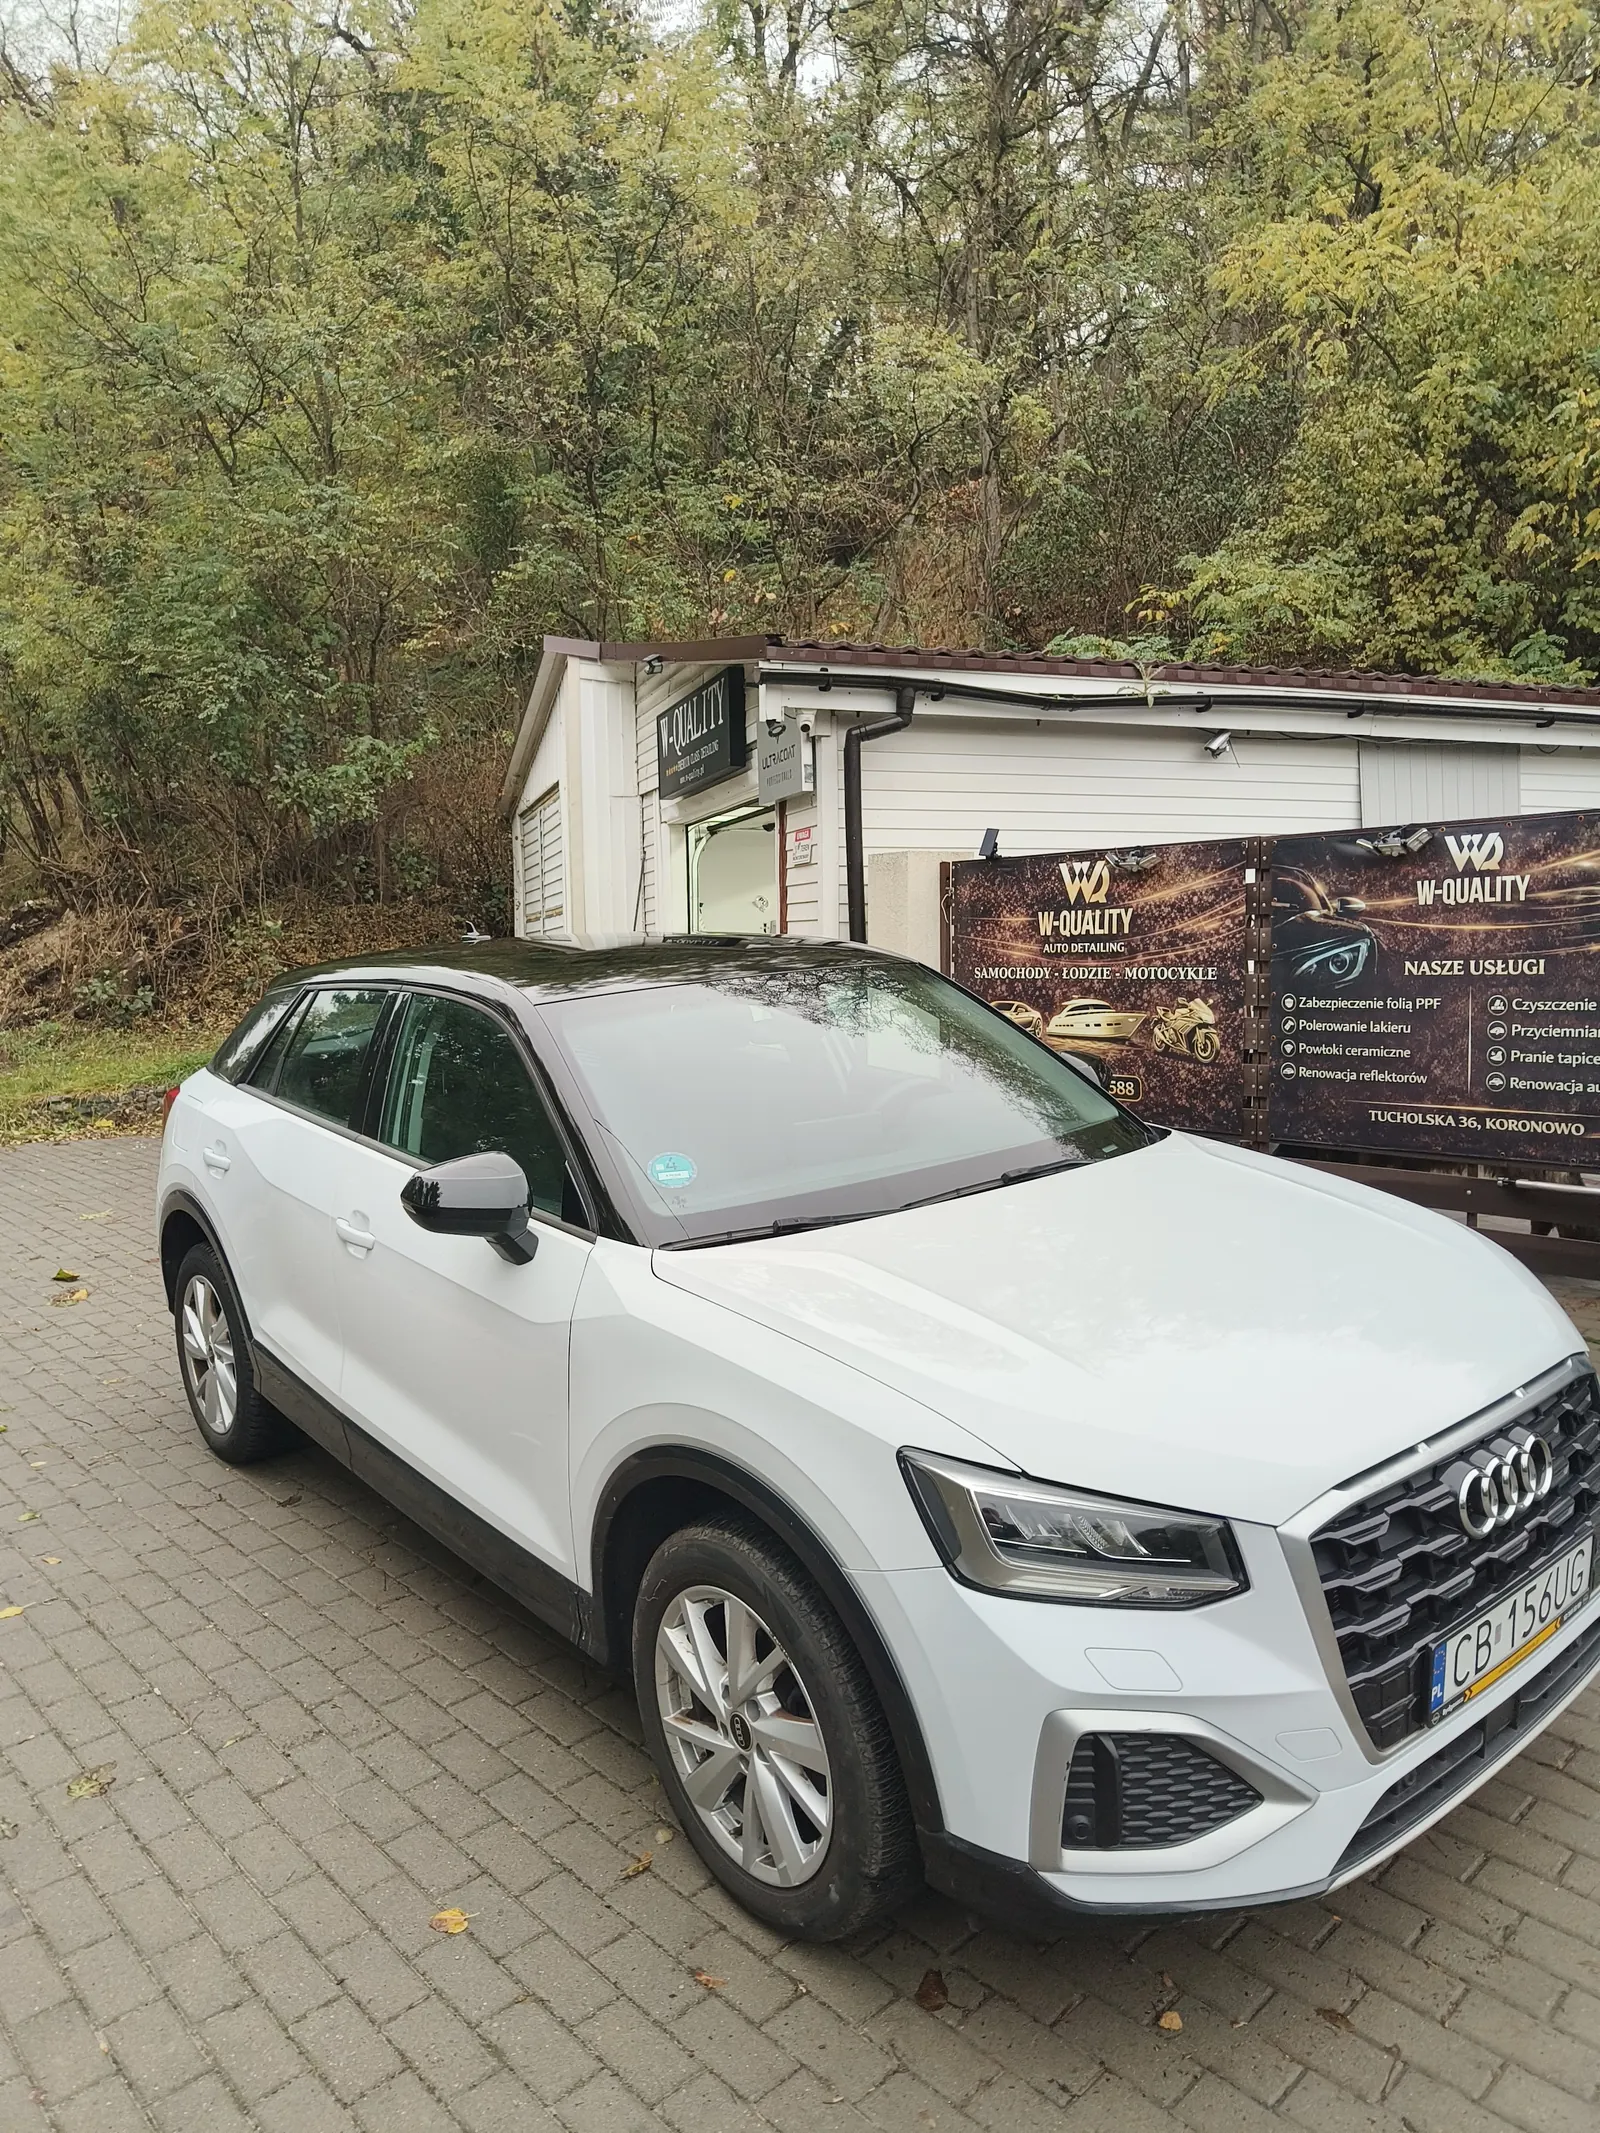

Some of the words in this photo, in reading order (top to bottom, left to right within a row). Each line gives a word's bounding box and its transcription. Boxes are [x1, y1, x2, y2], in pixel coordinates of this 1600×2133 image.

[660, 678, 724, 758] W-QUALITY
[762, 744, 795, 769] ULTRACOAT
[1416, 874, 1530, 906] W-QUALITY
[1037, 908, 1133, 937] W-QUALITY
[1043, 943, 1069, 954] AUTO
[1071, 942, 1125, 953] DETAILING
[974, 967, 1052, 980] SAMOCHODY
[1062, 967, 1111, 980] ŁODZIE
[1124, 967, 1217, 980] MOTOCYKLE
[1403, 960, 1464, 976] NASZE
[1469, 958, 1545, 975] USŁUGI
[1299, 997, 1384, 1011] Zabezpieczenie
[1387, 997, 1413, 1012] folią
[1415, 998, 1441, 1009] PPF
[1512, 998, 1597, 1014] Czyszczenie
[1299, 1020, 1367, 1032] Polerowanie
[1370, 1021, 1411, 1033] lakieru
[1511, 1024, 1600, 1040] Przyciemnia
[1299, 1043, 1343, 1055] Powłoki
[1345, 1046, 1411, 1058] ceramiczne
[1510, 1050, 1554, 1063] Pranie
[1299, 1067, 1357, 1082] Renowacja
[1359, 1070, 1428, 1084] reflektorów
[1109, 1080, 1135, 1096] 588
[1510, 1077, 1583, 1095] Renowacja
[1368, 1110, 1455, 1127] TUCHOLSKA
[1458, 1116, 1482, 1130] 36,
[1485, 1118, 1585, 1136] KORONOWO
[1453, 1619, 1492, 1687] CB
[1508, 1548, 1585, 1648] 156UG
[1431, 1684, 1443, 1701] PL
